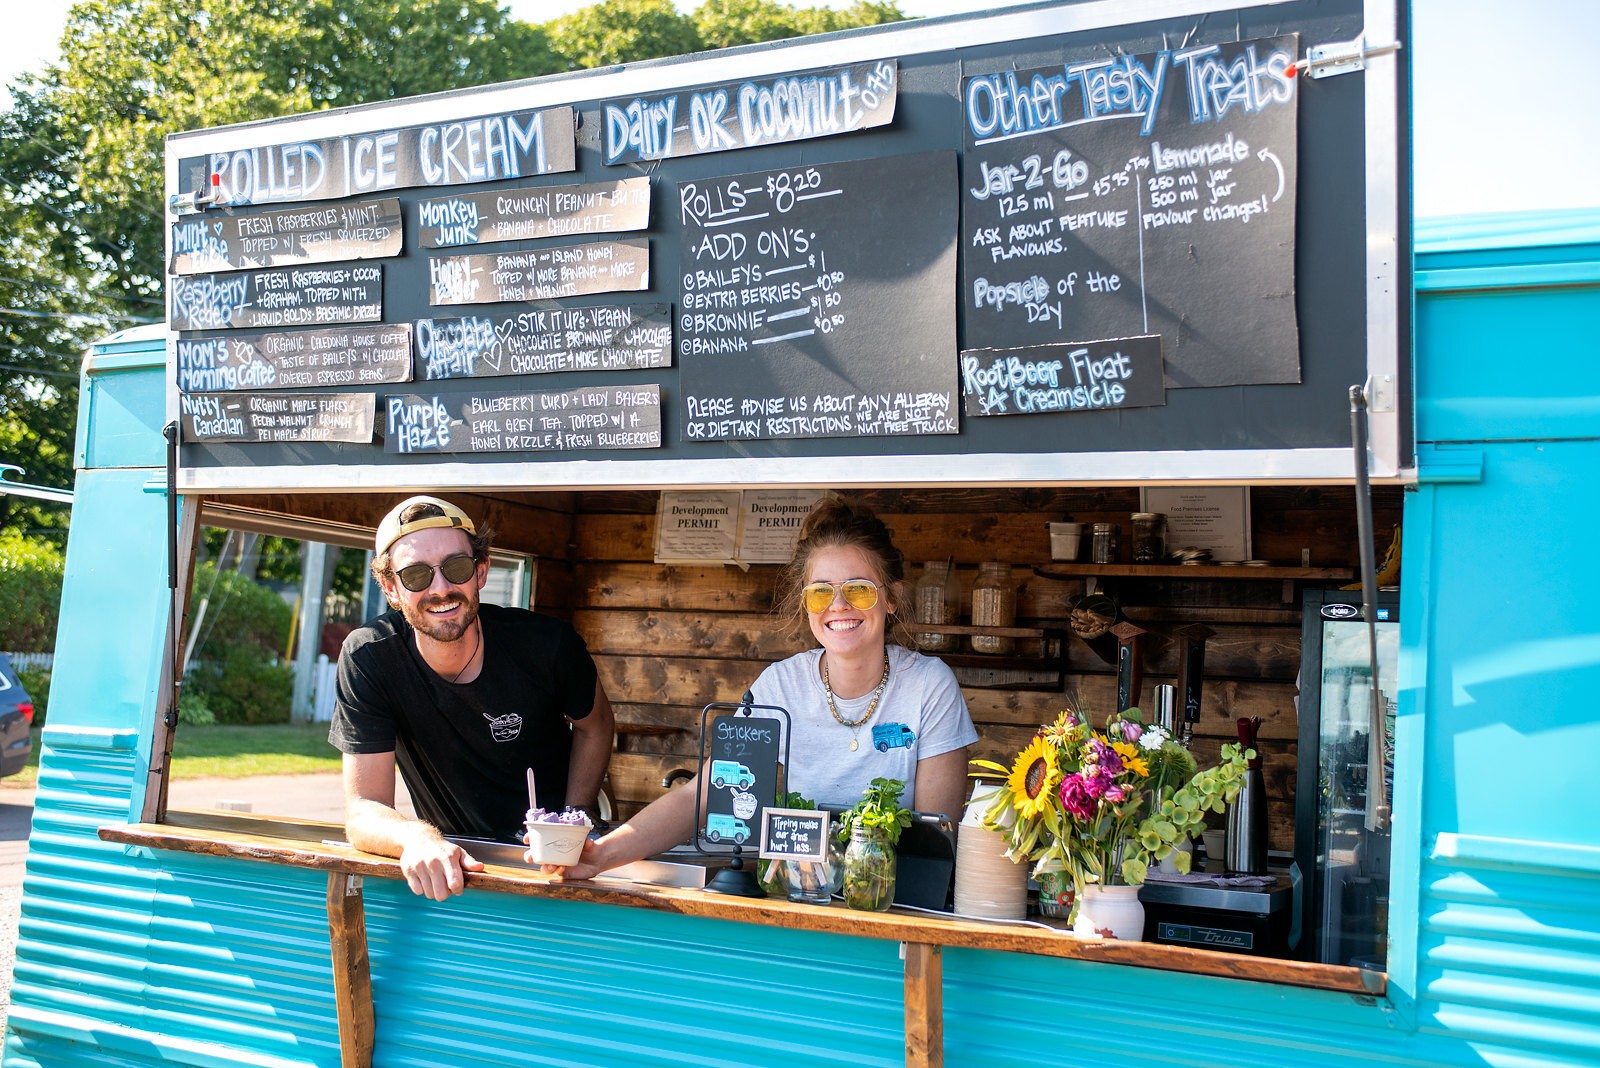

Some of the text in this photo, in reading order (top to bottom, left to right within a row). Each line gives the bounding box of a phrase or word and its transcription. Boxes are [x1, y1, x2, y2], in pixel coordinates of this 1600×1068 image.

[967, 46, 1295, 139] Other Tasty Treats
[1152, 131, 1252, 174] Lemonade
[210, 142, 327, 206] ROLLED
[341, 132, 399, 196] ICE
[1148, 170, 1198, 191] 250 ml
[497, 190, 609, 215] CRUNCHY PEANUT
[999, 197, 1029, 218] 125
[1034, 192, 1054, 211] ml
[1151, 191, 1177, 208] 500
[1180, 187, 1199, 203] ml
[237, 208, 337, 238] FRESH RASPBERRIES
[973, 210, 1129, 248] ASK ABOUT FEATURE
[238, 236, 279, 254] TOPPED
[299, 231, 331, 248] FRESH
[336, 225, 391, 244] SQUEEZED
[497, 249, 585, 271] BANANA ISLAND
[254, 267, 380, 293] FRESH COCOA
[490, 262, 636, 286] TOPPED MORE BANANA MORE
[172, 272, 251, 316] Raspberry
[304, 285, 366, 304] TOPPED WITH
[499, 284, 526, 301] HONEY
[740, 282, 802, 306] BERRIES
[973, 271, 1122, 312] Popsicle of the
[189, 302, 234, 330] Rodeo
[1025, 301, 1062, 330] Day
[414, 315, 497, 356] Chocolate
[550, 310, 564, 332] IT
[590, 306, 632, 327] VEGAN
[266, 336, 304, 354] ORGANIC
[352, 333, 376, 347] HOUSE
[508, 332, 562, 355] CHOCOLATE
[279, 353, 305, 368] TASTE
[309, 352, 321, 366] OF
[511, 351, 599, 374] CHOCOLATE MORE
[1068, 347, 1134, 386] Float
[179, 360, 277, 391] Morning Coffee
[279, 369, 356, 385] COVERED ESPRESSO
[250, 397, 289, 413] ORGANIC
[292, 397, 318, 412] MAPLE
[471, 391, 610, 415] BLUEBERRY CURD LADY
[687, 395, 735, 420] PLEASE
[742, 396, 785, 416] ADVISE
[790, 396, 808, 413] US
[813, 394, 856, 414] ABOUT
[857, 393, 891, 412] ANY
[1013, 380, 1127, 414] Creamsicle
[193, 411, 245, 438] Canadian
[472, 411, 641, 435] EARL GREY TOPPED A
[856, 407, 946, 422] WE ARE NOT A
[857, 417, 957, 435] NUT FREE TRUCK
[258, 427, 331, 441] PEI MAPLE SYRUP
[397, 421, 451, 453] Haze
[471, 434, 502, 451] HONEY
[564, 434, 593, 448] FRESH
[598, 430, 660, 446] BLUEBERRIES
[687, 422, 706, 439] OR
[708, 419, 762, 439] DIETARY
[671, 505, 729, 519] Development
[751, 503, 813, 516] Development
[677, 519, 721, 529] PERMIT
[758, 517, 804, 528] PERMIT
[718, 722, 772, 745] Stickers
[772, 816, 819, 832] Tipping makes
[771, 839, 789, 852] hurt
[776, 831, 809, 842] our arms
[1197, 929, 1246, 946] true
